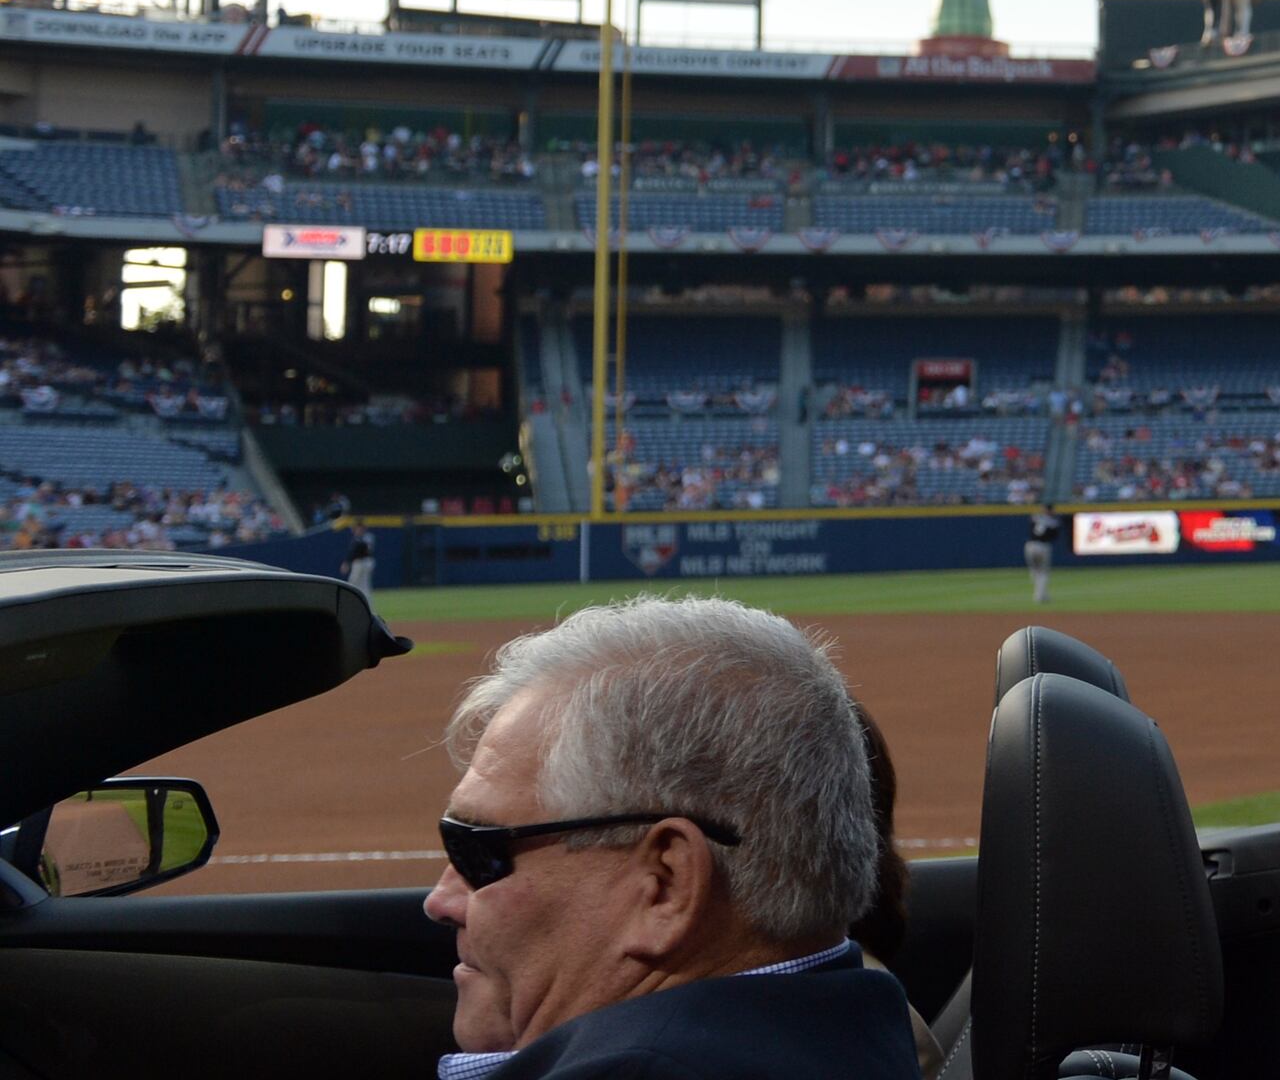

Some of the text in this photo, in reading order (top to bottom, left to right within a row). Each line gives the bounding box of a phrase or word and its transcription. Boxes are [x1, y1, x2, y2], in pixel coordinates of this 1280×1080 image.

[294, 37, 386, 53] UPGRADE
[397, 42, 445, 57] YOUR
[366, 232, 413, 255] 7:17
[726, 553, 827, 574] NETWORK
